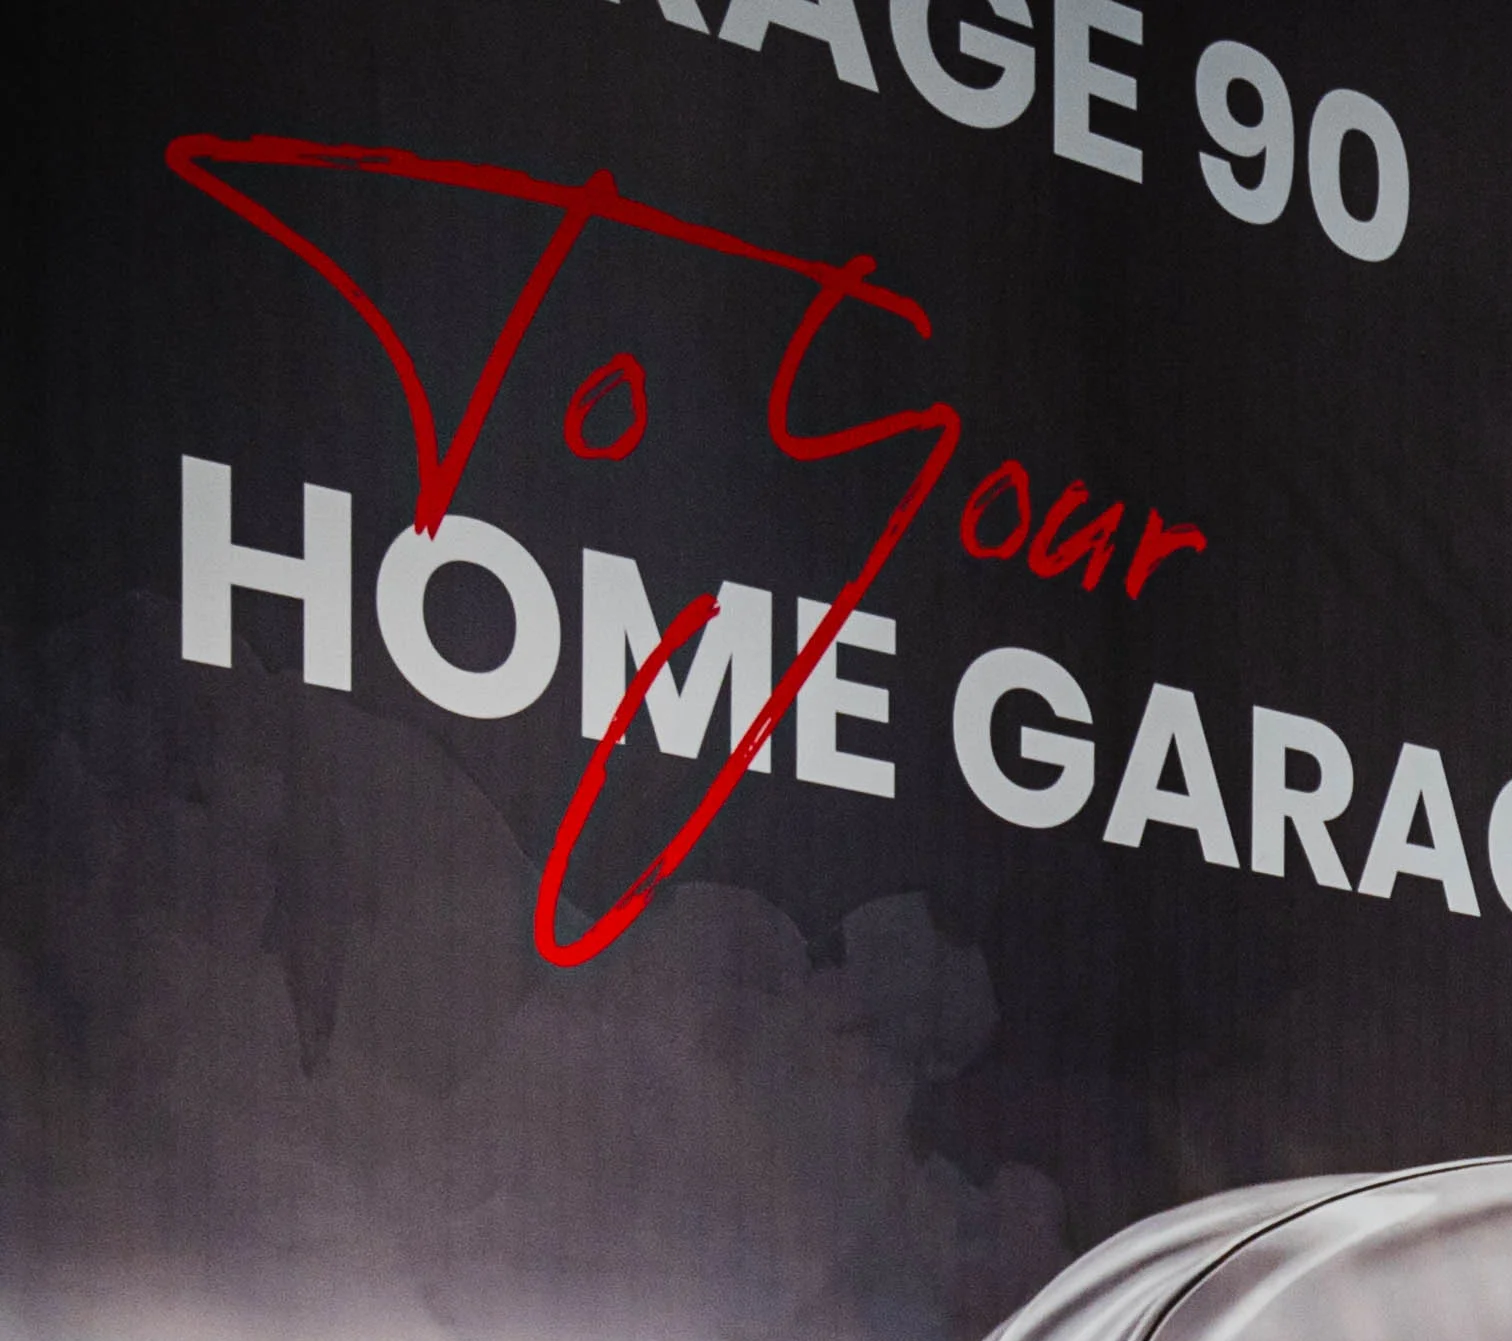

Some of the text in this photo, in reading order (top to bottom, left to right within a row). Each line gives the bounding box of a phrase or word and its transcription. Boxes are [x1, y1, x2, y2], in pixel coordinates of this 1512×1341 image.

[1195, 40, 1410, 262] 90
[166, 134, 650, 540] To
[181, 454, 897, 799] HOME
